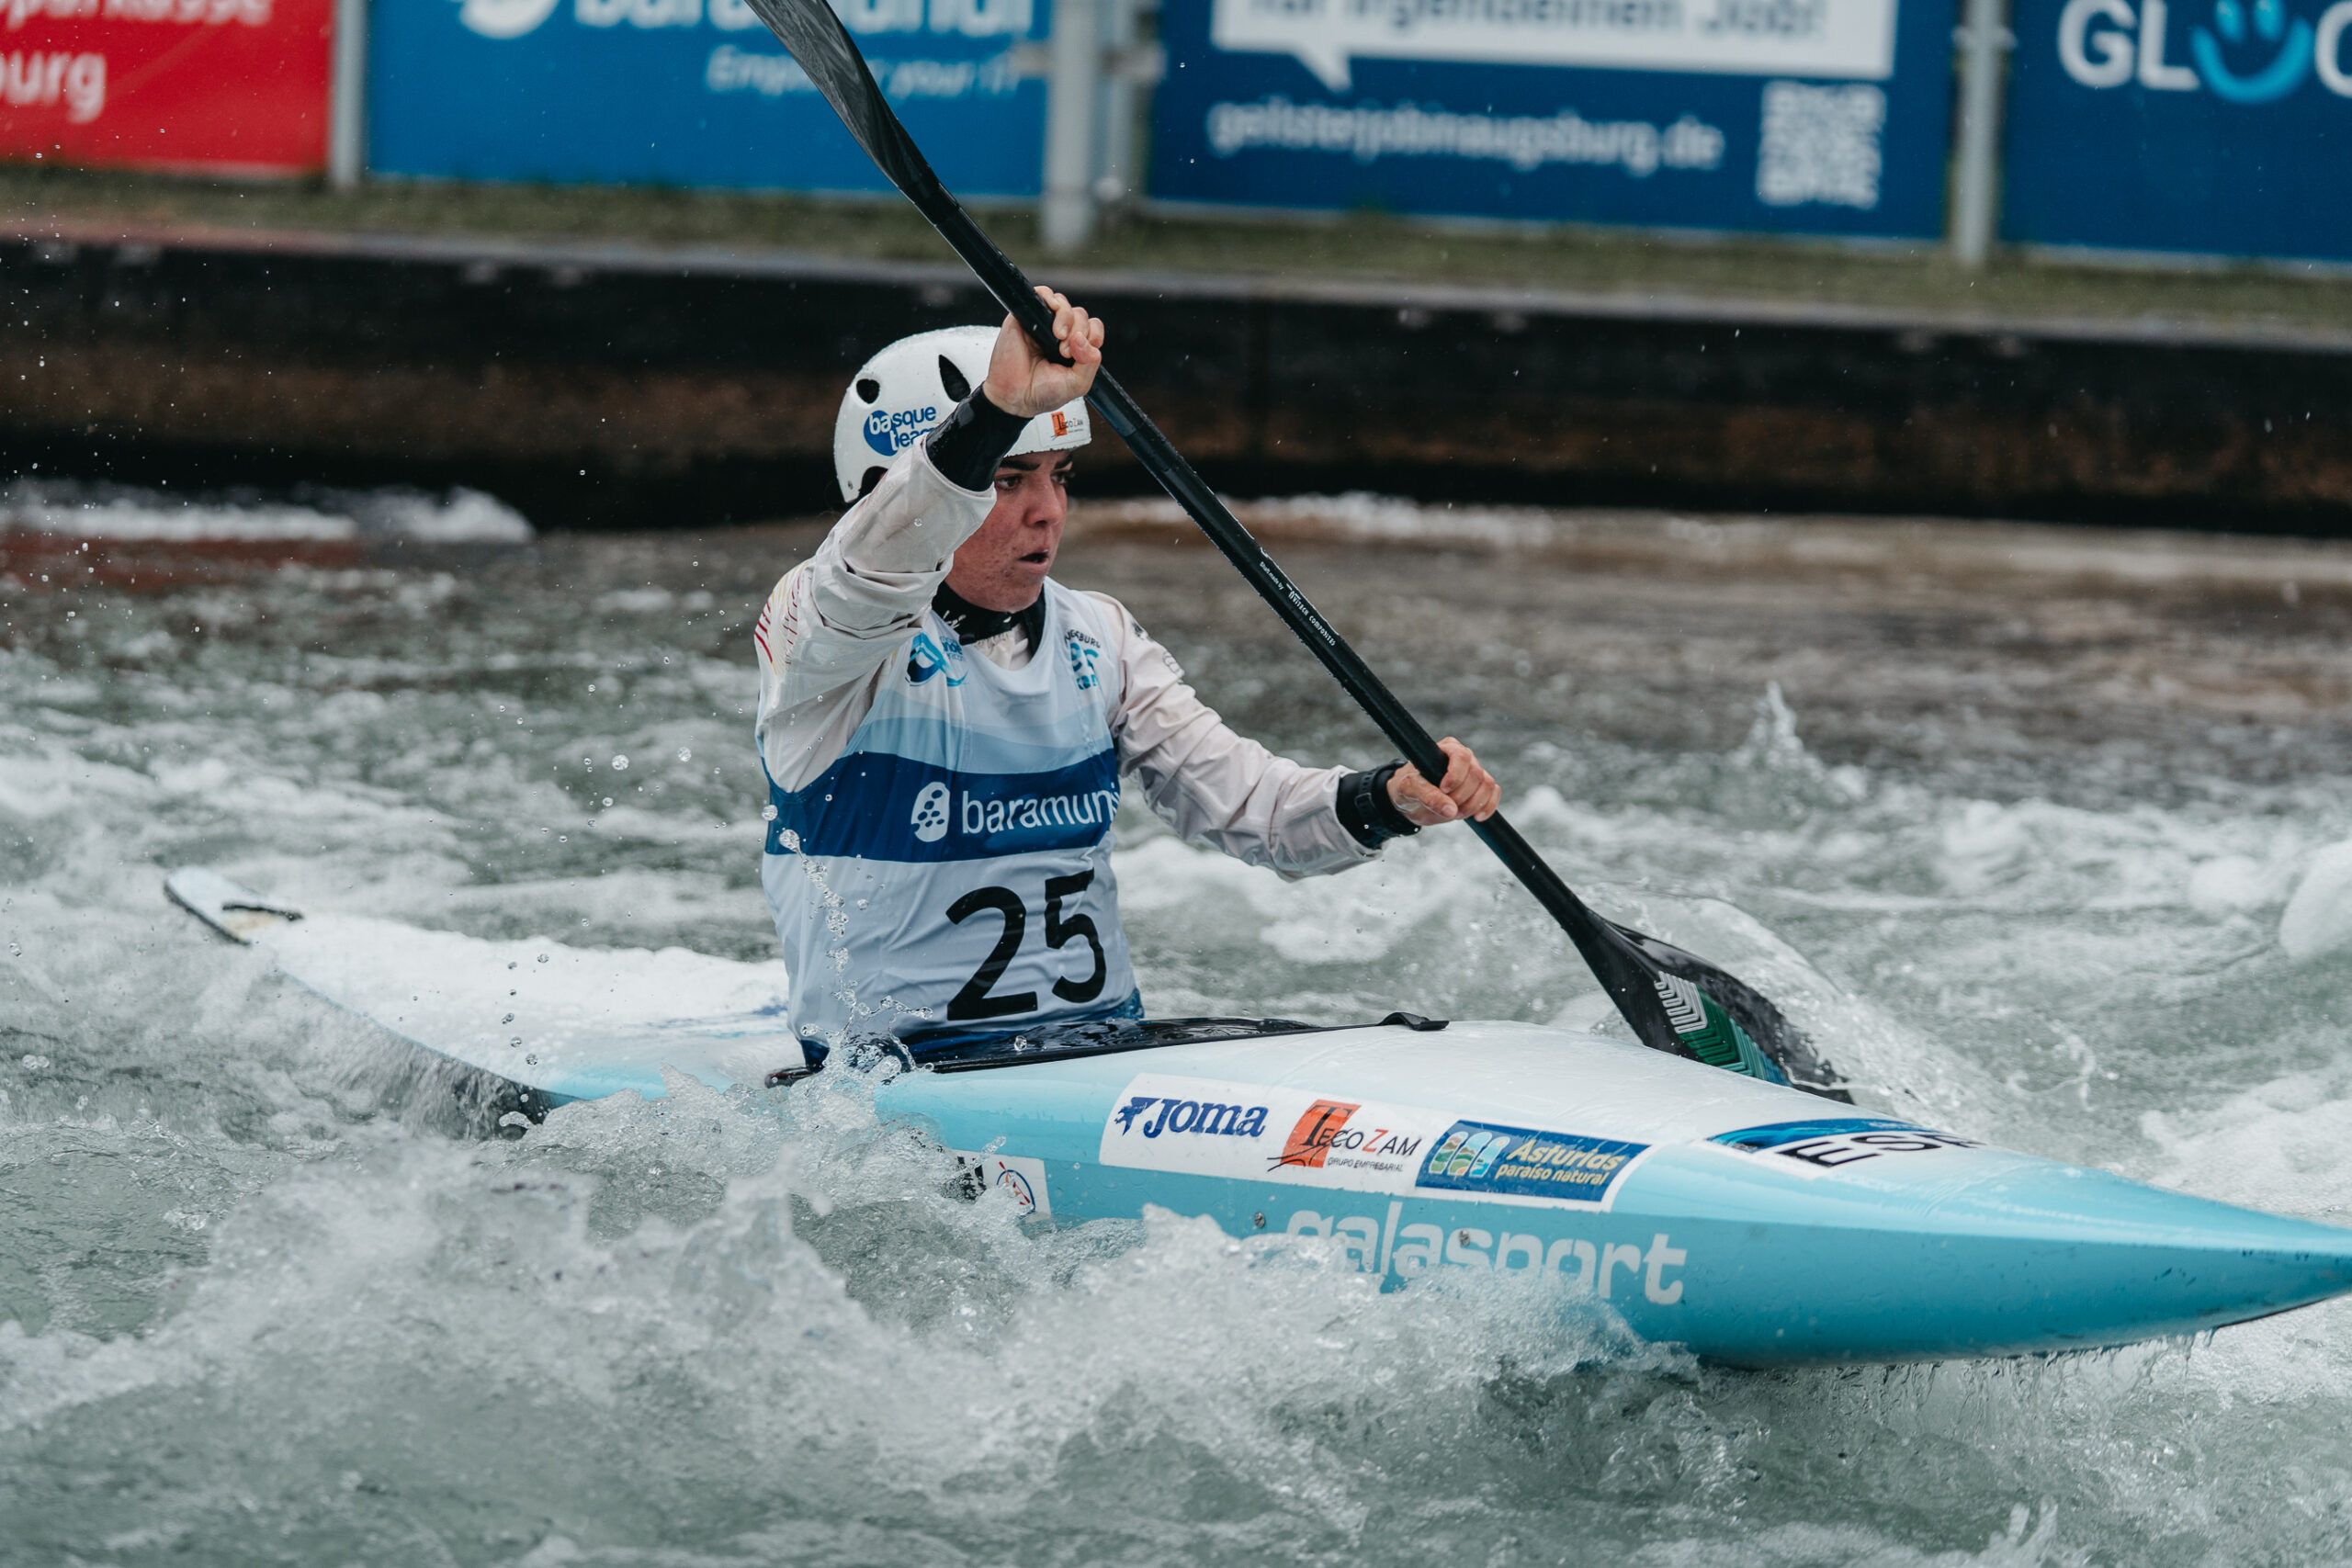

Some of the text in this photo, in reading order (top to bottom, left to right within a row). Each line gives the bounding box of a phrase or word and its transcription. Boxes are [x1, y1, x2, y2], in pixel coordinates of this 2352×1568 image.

[0, 50, 106, 124] urg
[869, 406, 936, 435] basque
[889, 426, 935, 451] tea
[945, 868, 1107, 1021] 25
[1328, 1156, 1404, 1172] GRUPO EMPRESARIAL
[1506, 1139, 1624, 1170] Asturias
[1494, 1163, 1611, 1186] paraíso natural
